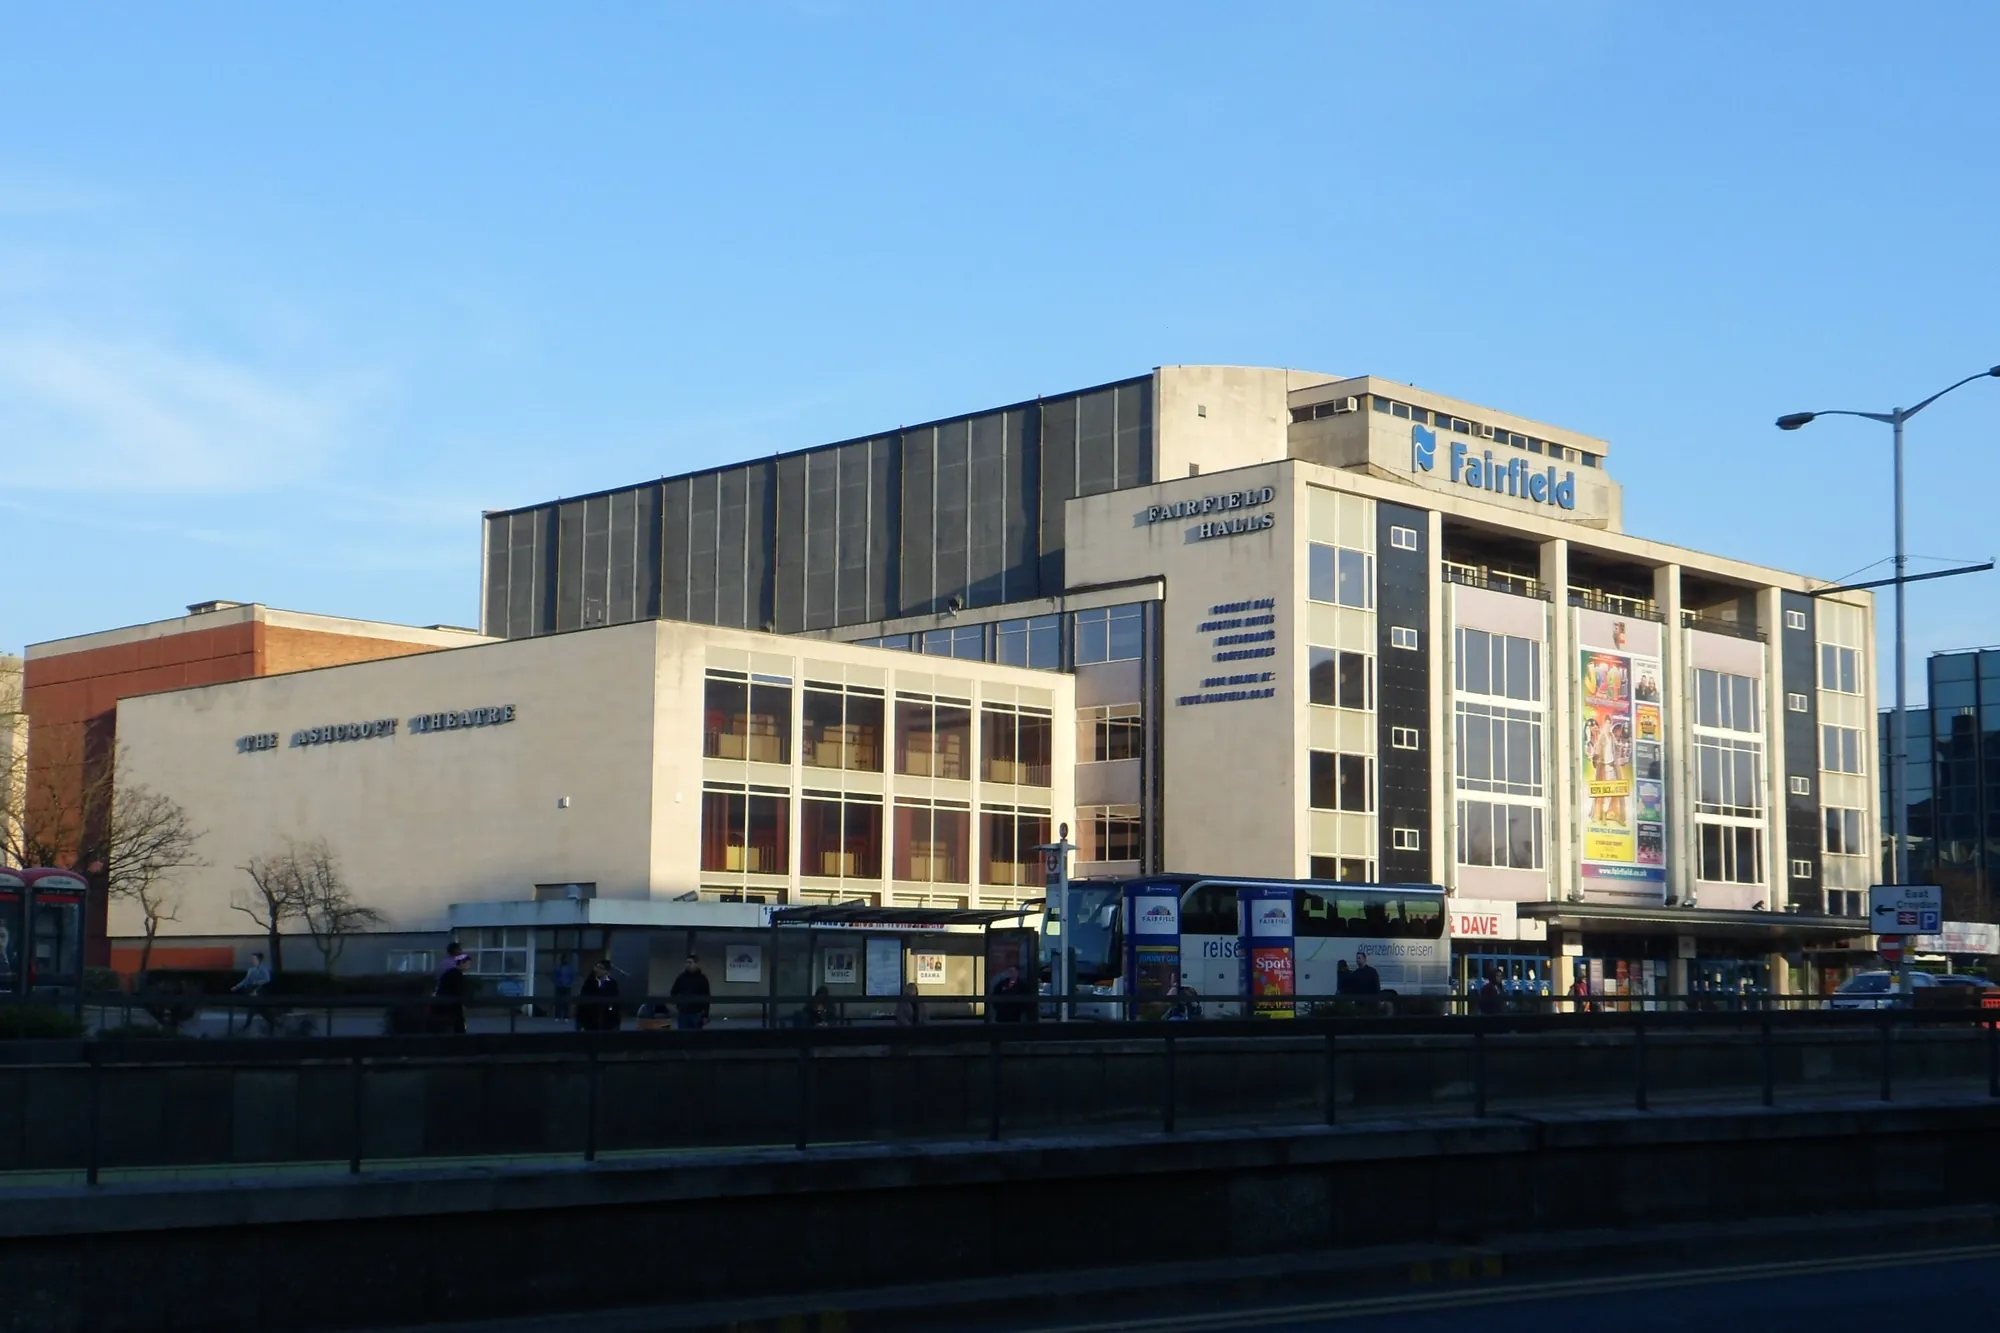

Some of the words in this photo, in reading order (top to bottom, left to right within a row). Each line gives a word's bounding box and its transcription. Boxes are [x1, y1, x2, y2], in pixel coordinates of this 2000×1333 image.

[1451, 441, 1575, 510] Fairfield
[1146, 486, 1275, 522] FAIRFIELD
[1198, 512, 1275, 539] HALLS
[1213, 600, 1251, 614] CONCERT
[1217, 630, 1275, 646] RESTAURANTS
[1217, 647, 1275, 662] CONFERENCES
[243, 731, 279, 751] THE
[295, 718, 398, 746] ASHCROFT
[415, 703, 517, 731] THEATRE
[1905, 889, 1929, 898] East
[1896, 900, 1939, 909] Croydon
[1461, 915, 1498, 935] DAVE
[1923, 912, 1936, 929] P
[1357, 943, 1405, 957] grenzenlos
[1407, 943, 1433, 957] reisen
[1255, 957, 1291, 971] Spot's
